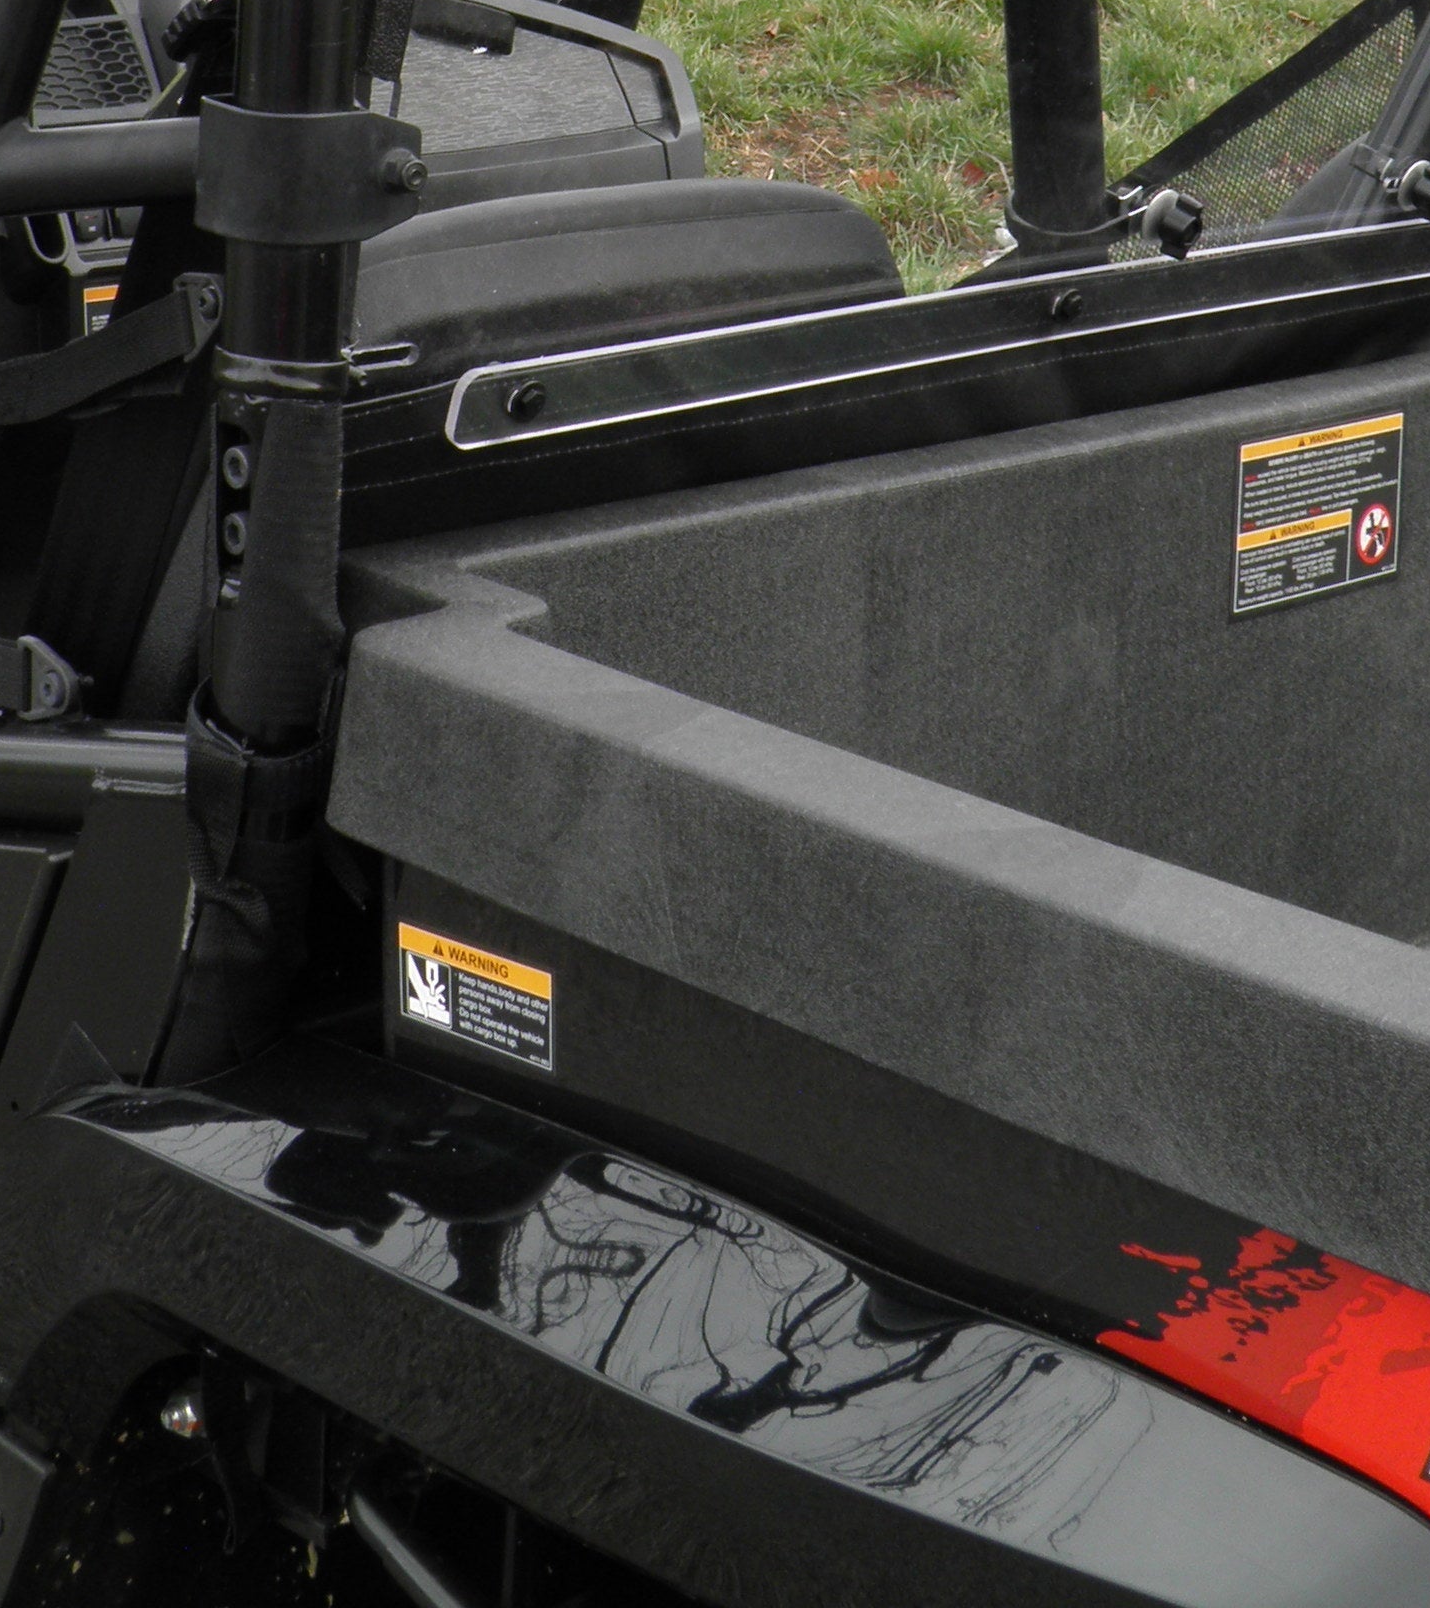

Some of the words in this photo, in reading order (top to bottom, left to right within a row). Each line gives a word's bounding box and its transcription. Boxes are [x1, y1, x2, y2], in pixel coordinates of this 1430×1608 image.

[1309, 430, 1344, 445] WARNING
[1281, 522, 1316, 537] WARNING
[448, 945, 509, 979] WARNING
[459, 973, 477, 987] Keep
[516, 994, 530, 1006] and
[531, 999, 549, 1012] other
[459, 997, 478, 1011] cargo
[459, 985, 485, 1001] persons
[486, 995, 504, 1010] away
[504, 1000, 521, 1014] from
[521, 1007, 547, 1026] closing
[459, 1006, 469, 1018] Do
[470, 1012, 481, 1023] not
[482, 1017, 507, 1033] operate
[508, 1025, 520, 1037] the
[520, 1031, 545, 1046] vehicle
[459, 1020, 473, 1032] with
[474, 1025, 493, 1039] cargo
[493, 1030, 506, 1043] box
